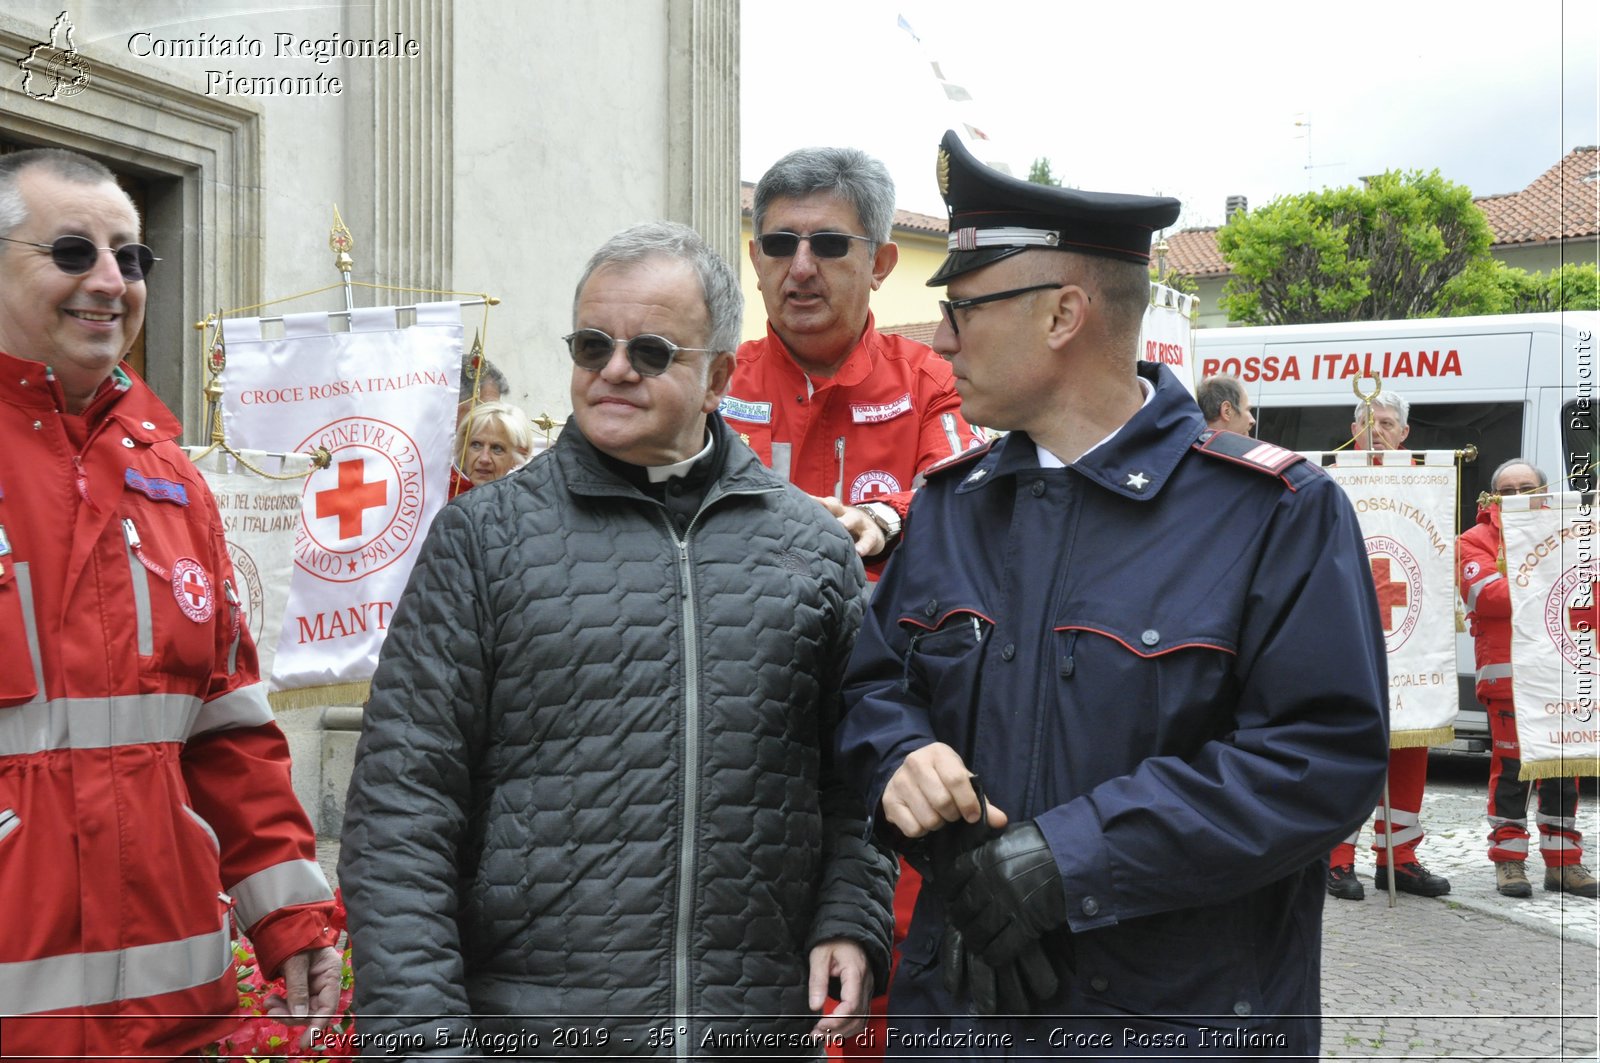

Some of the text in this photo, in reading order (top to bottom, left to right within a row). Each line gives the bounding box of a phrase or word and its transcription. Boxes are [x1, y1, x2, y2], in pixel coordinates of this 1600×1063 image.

[1202, 350, 1462, 382] ROSSA ITALIANA
[240, 371, 449, 405] CROCE ROSSA ITALIANA
[1385, 475, 1401, 485] DEL
[1402, 475, 1450, 485] SOCCORSO
[234, 494, 250, 510] DEL
[253, 494, 299, 511] SOCCORSO
[294, 423, 421, 576] CONVE GINEVRA 22 AGOSTO 1864
[224, 515, 238, 532] SA
[1356, 497, 1447, 556] OSSA ITALIANA
[1515, 535, 1559, 588] CROCE
[1399, 551, 1411, 566] 22
[1408, 563, 1422, 613] AGOSTO
[296, 601, 393, 644] MANT
[1432, 673, 1445, 686] DI
